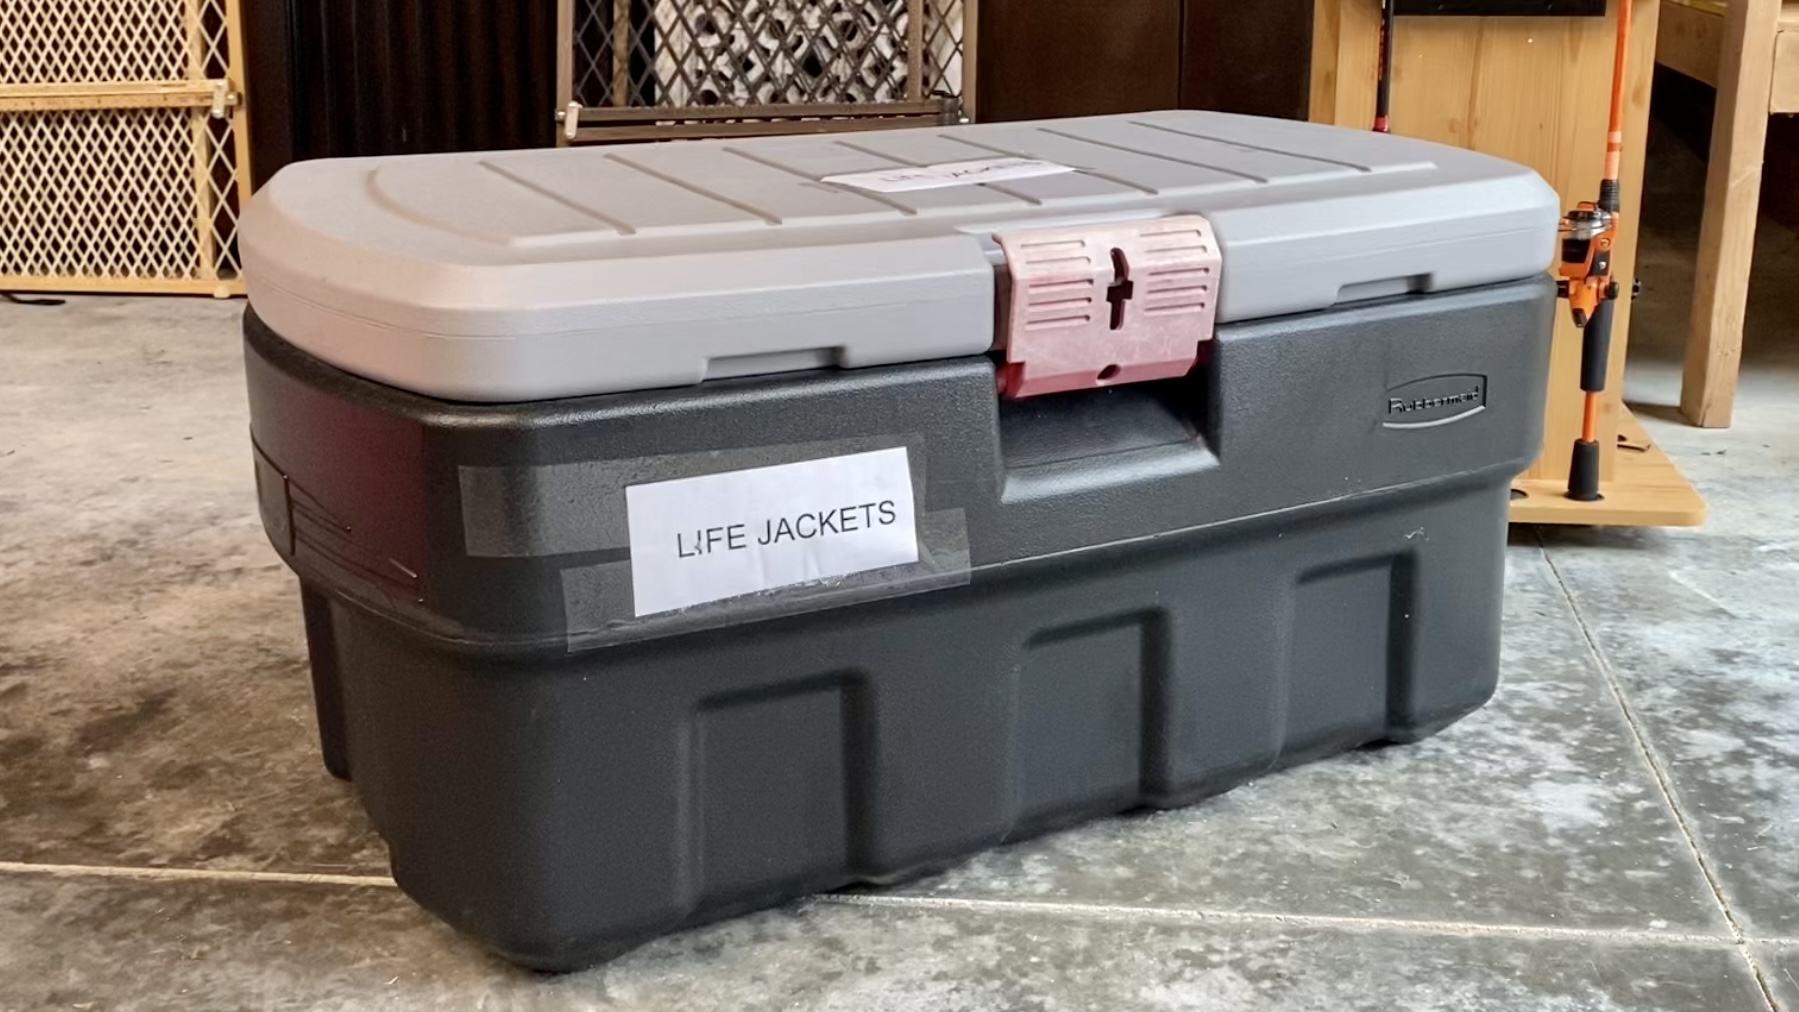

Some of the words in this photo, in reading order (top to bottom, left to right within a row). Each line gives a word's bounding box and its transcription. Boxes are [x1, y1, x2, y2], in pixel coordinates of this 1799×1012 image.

[1388, 385, 1479, 414] Rubbermaid
[676, 523, 747, 559] LIFE
[757, 500, 897, 546] JACKETS
